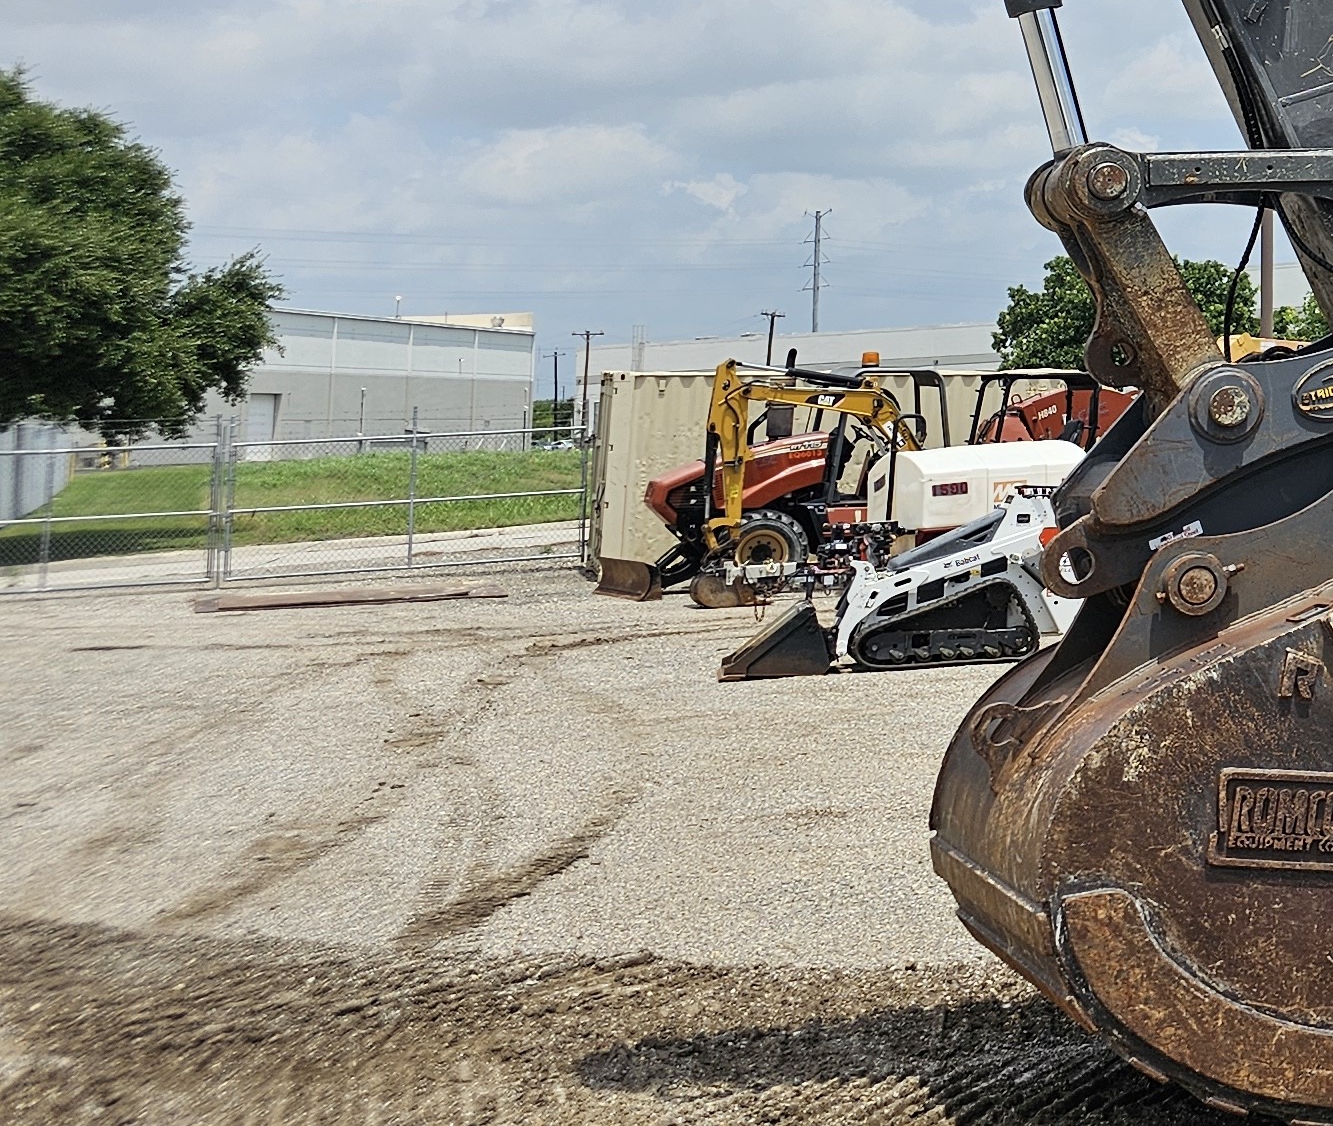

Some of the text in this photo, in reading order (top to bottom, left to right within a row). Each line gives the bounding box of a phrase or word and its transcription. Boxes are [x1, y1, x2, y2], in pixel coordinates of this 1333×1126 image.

[817, 394, 836, 406] CAT
[955, 554, 981, 567] Bobcat
[1281, 652, 1319, 699] R
[1228, 834, 1313, 852] EQUIPMENT
